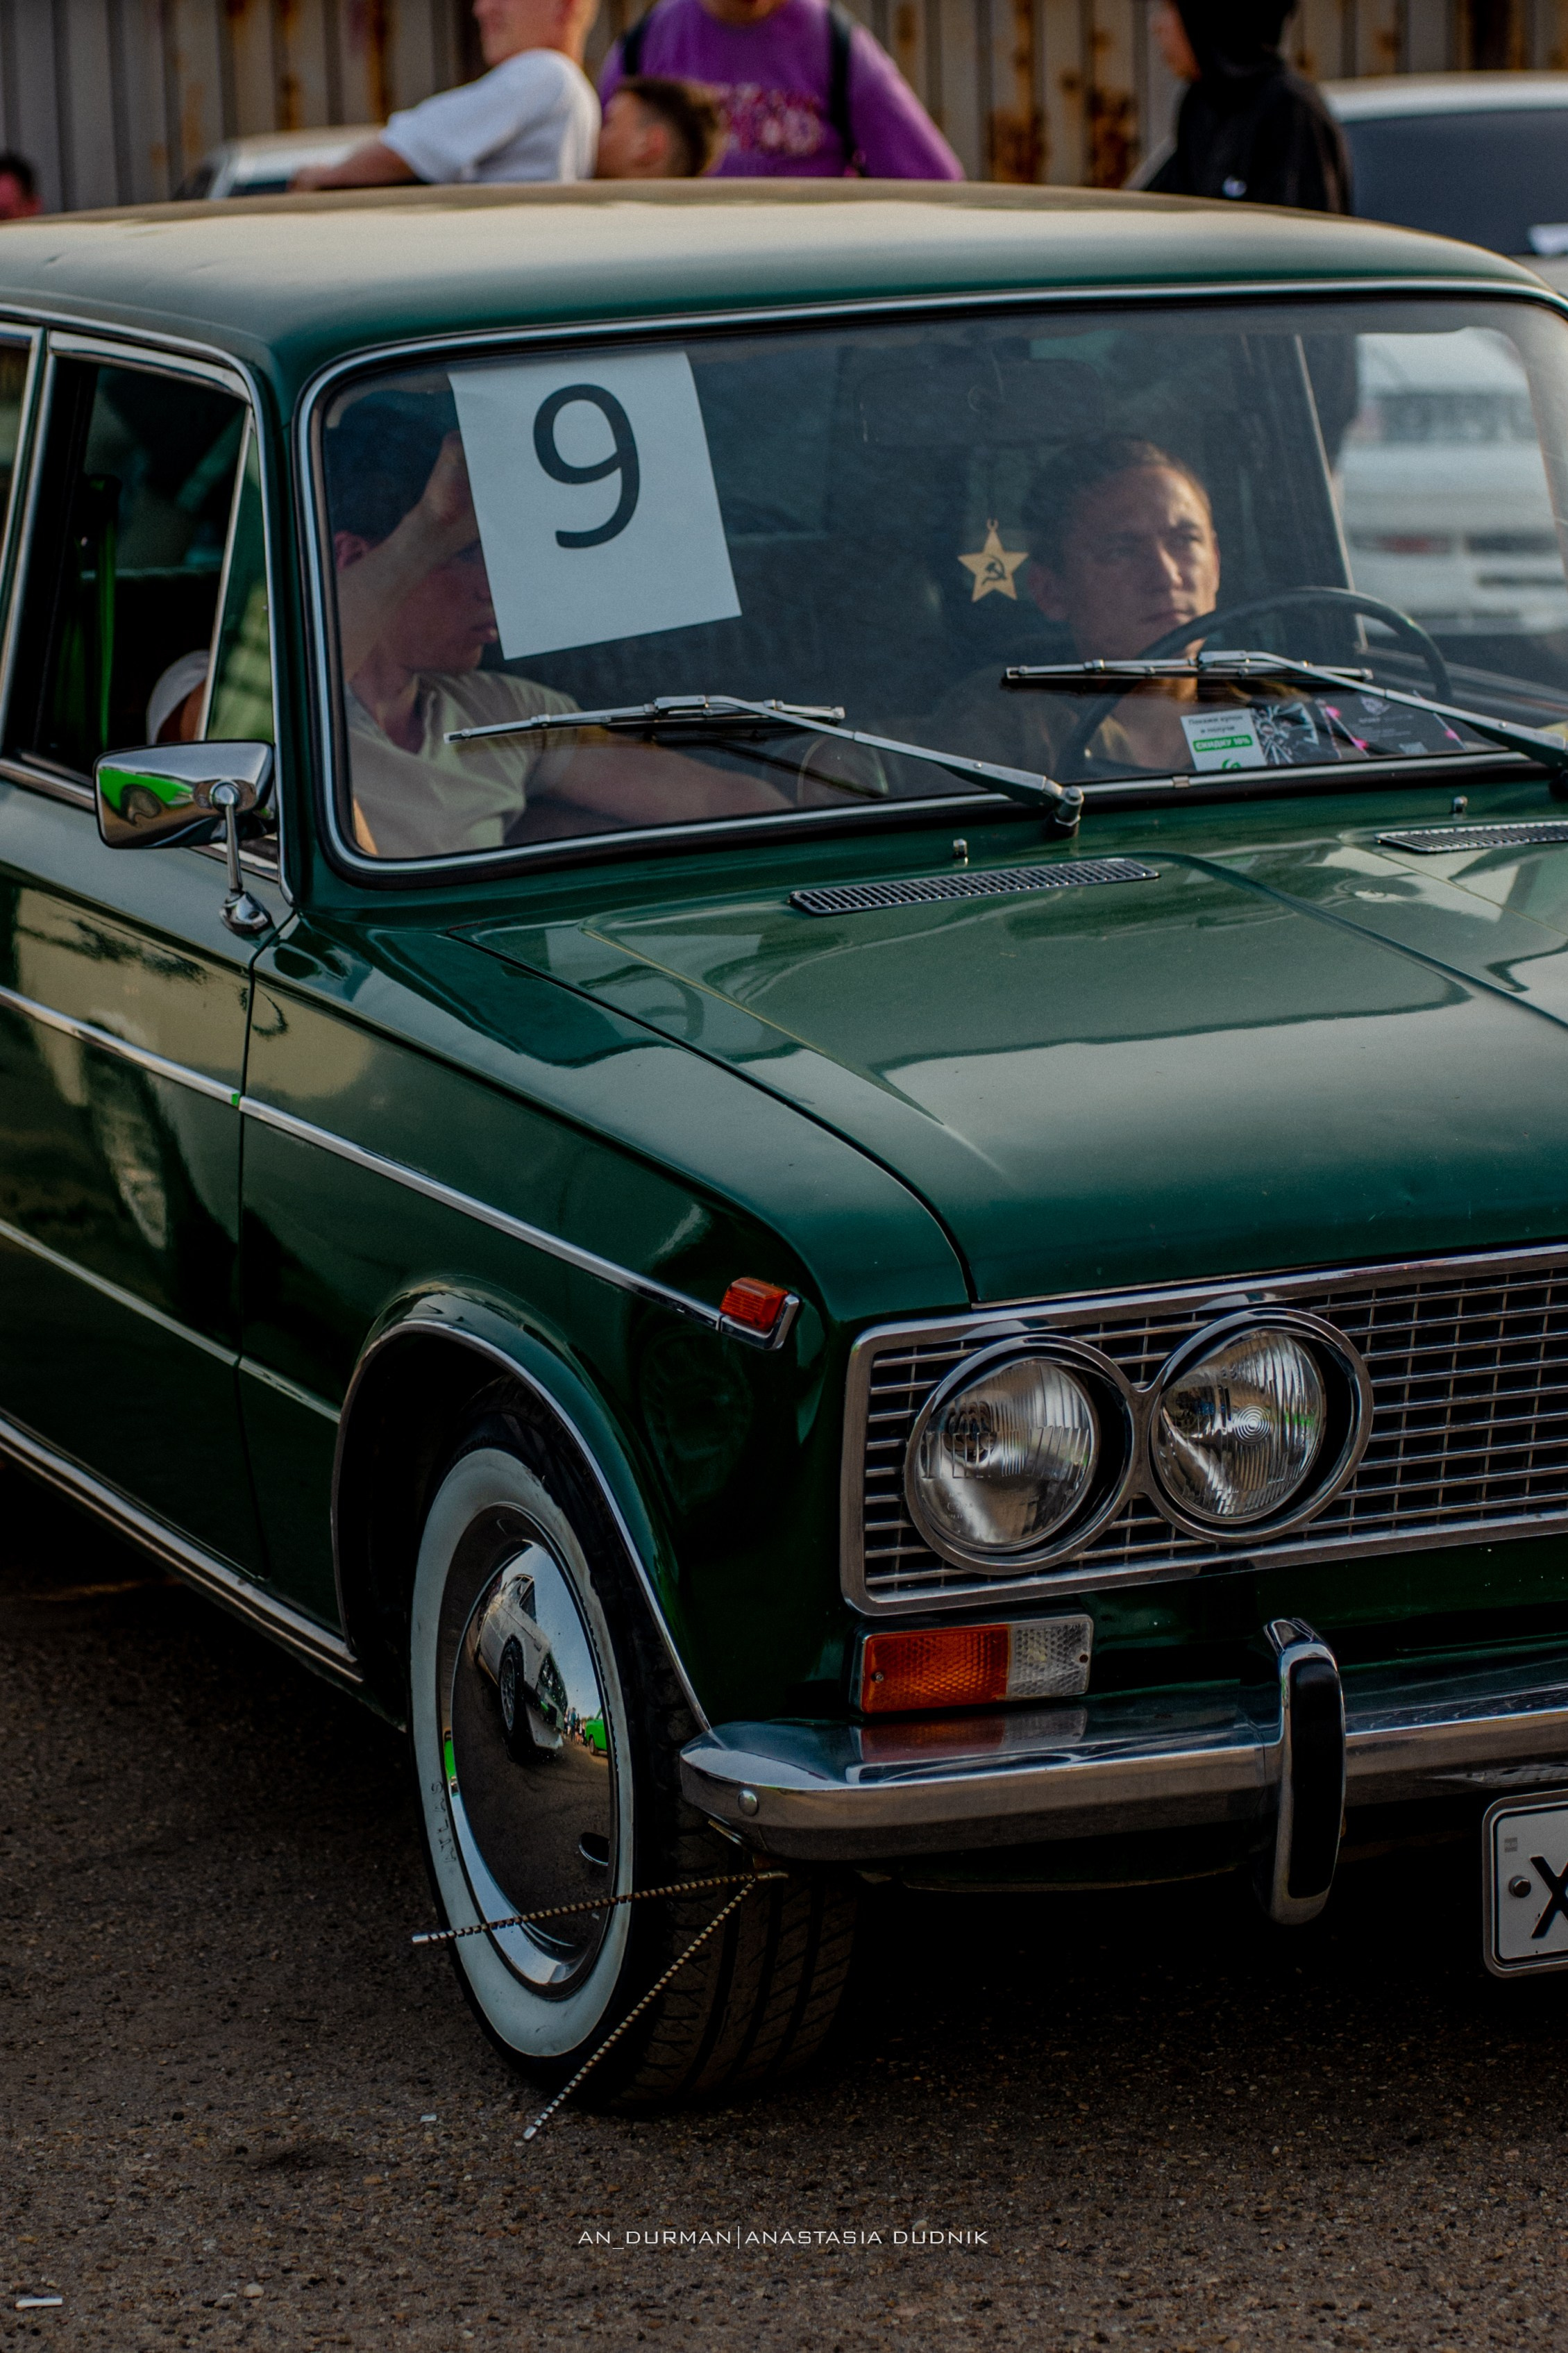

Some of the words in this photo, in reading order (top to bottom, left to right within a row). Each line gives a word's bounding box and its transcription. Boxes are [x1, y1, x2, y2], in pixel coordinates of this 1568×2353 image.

[534, 383, 640, 549] 9
[1195, 739, 1231, 750] СКИДКУ
[1233, 737, 1250, 745] 10%
[431, 1781, 457, 1863] ATLAS
